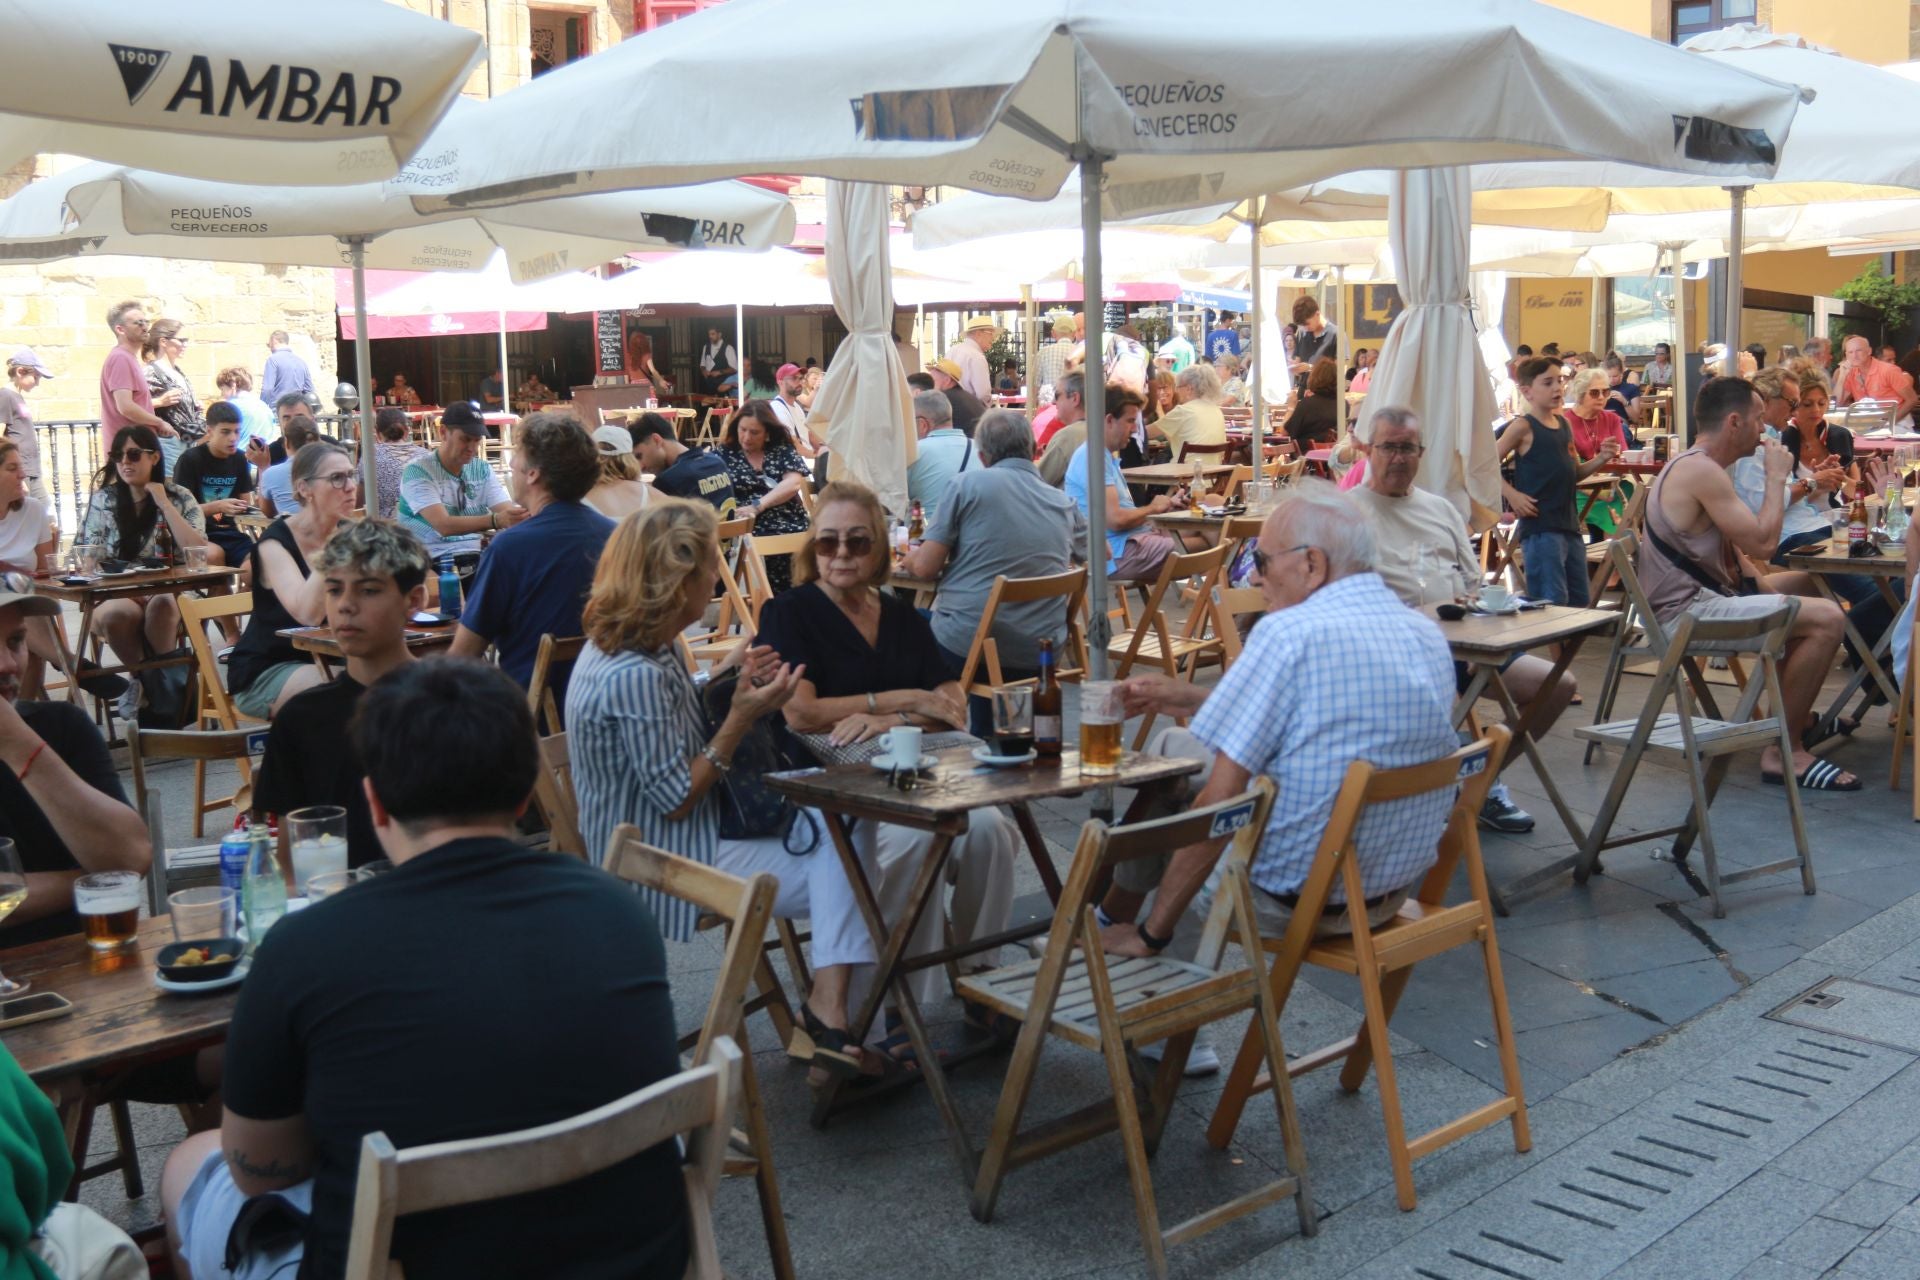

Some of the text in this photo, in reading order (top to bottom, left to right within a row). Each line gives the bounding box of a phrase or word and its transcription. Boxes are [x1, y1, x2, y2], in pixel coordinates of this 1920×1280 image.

[119, 50, 158, 66] 1900
[164, 54, 402, 127] AMBAR
[171, 204, 253, 221] PEQUEÑOS
[170, 222, 269, 233] CERVECEROS
[696, 218, 747, 246] BAR
